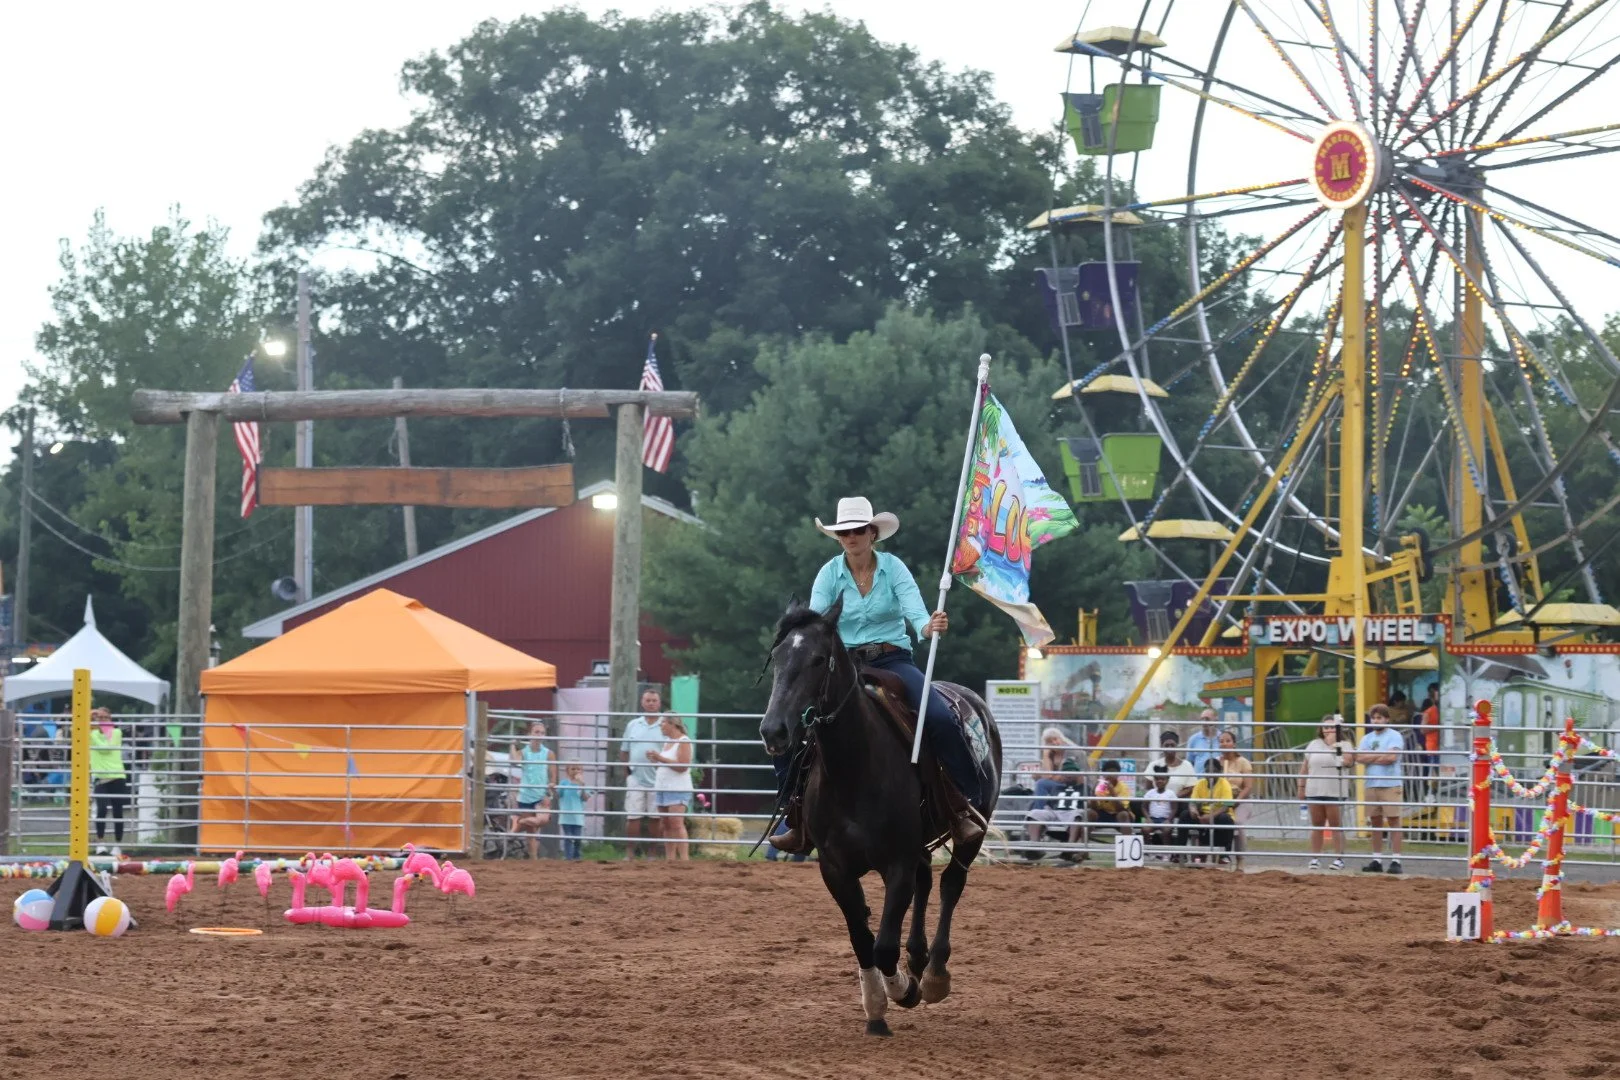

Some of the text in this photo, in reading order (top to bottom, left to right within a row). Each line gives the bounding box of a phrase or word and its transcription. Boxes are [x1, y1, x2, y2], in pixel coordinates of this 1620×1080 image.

[1330, 152, 1352, 180] M
[1269, 617, 1427, 643] EXPO WHEEL
[1117, 838, 1142, 861] 10
[1451, 904, 1477, 937] 11
